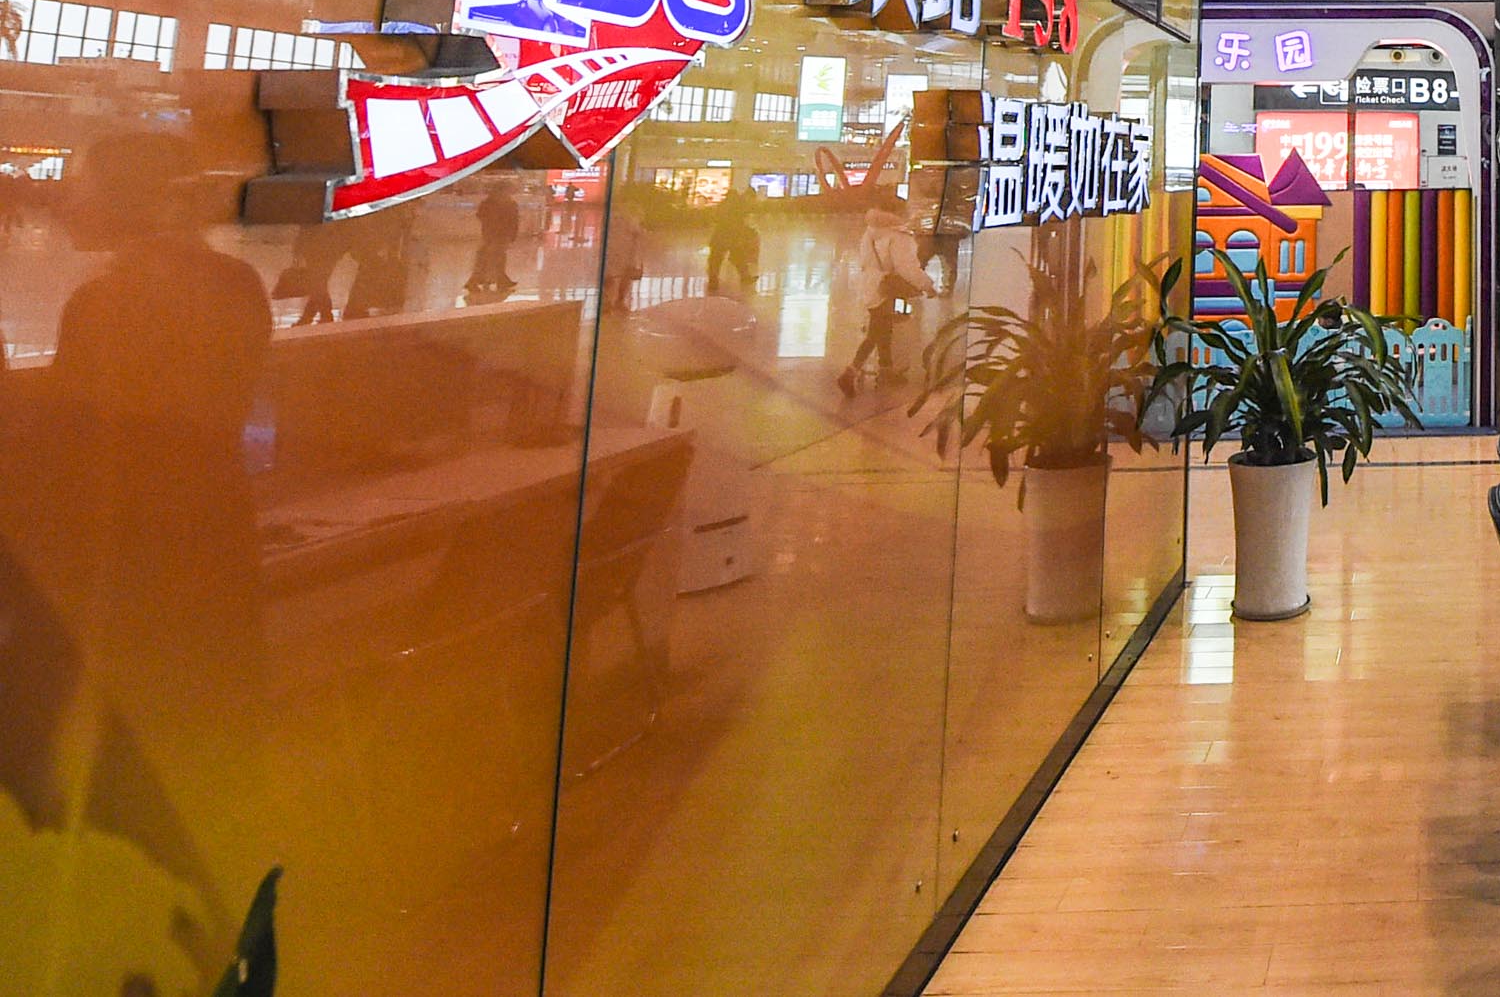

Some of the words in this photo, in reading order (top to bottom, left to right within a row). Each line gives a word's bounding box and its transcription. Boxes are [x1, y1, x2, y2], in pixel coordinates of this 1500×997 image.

[1214, 29, 1314, 73] 乐园
[1355, 76, 1406, 94] 检票口
[1355, 96, 1379, 104] Ticket
[1380, 95, 1406, 104] Check
[972, 90, 1153, 233] 温暖如在家
